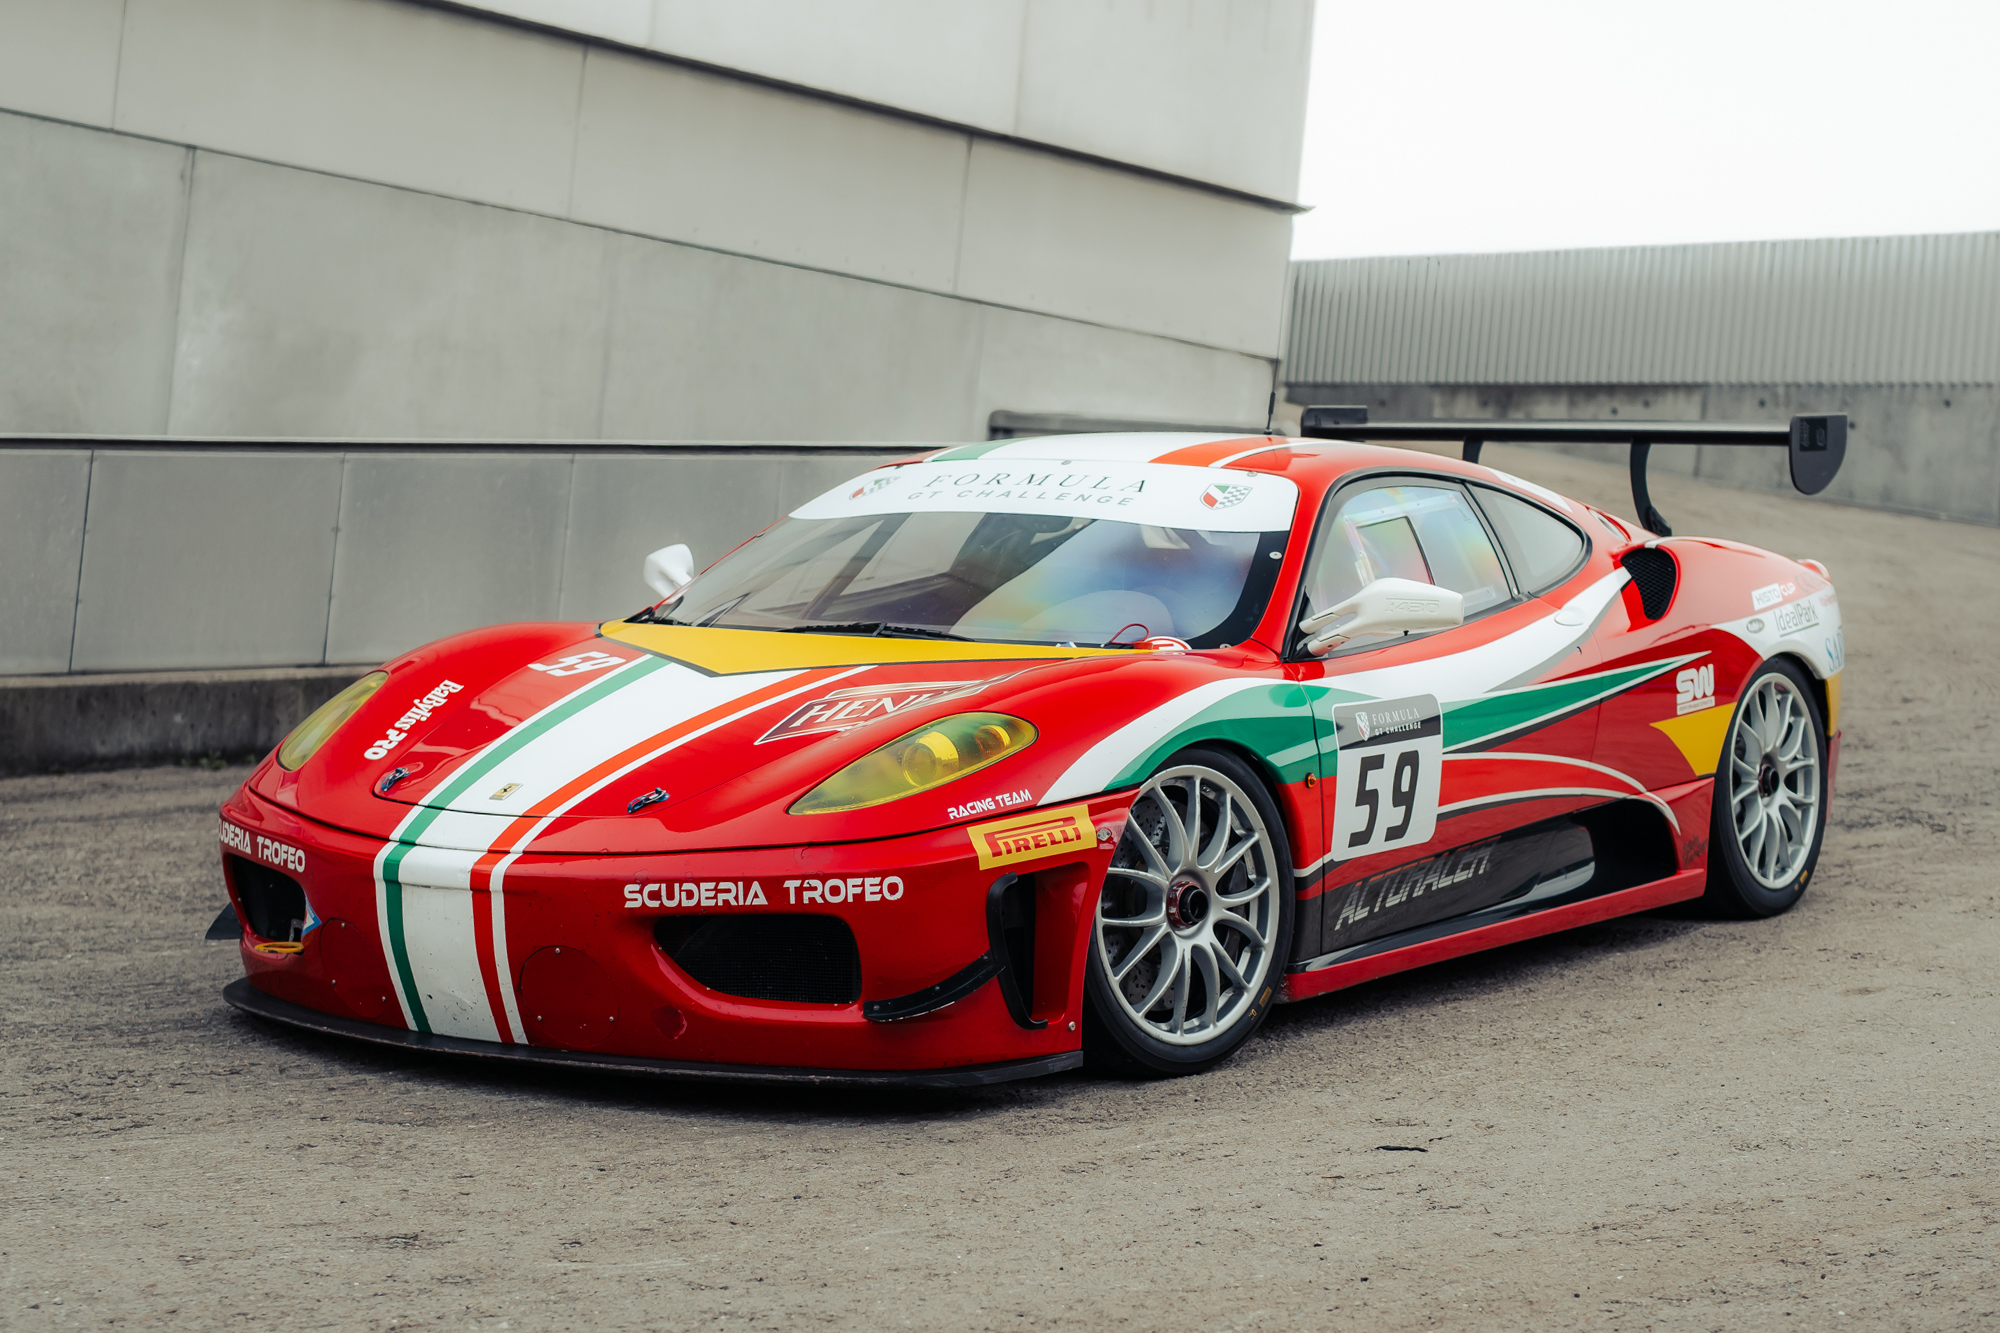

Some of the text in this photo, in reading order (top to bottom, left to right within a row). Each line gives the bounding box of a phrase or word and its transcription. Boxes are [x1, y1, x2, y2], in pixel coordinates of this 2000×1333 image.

[907, 489, 1135, 506] GT CHALLENGE
[923, 473, 1146, 494] FORMULA
[1773, 599, 1819, 632] IdealPark
[527, 651, 627, 677] 59
[363, 679, 465, 761] BaByliss PRO
[1371, 707, 1420, 725] FORMULA
[1385, 721, 1422, 734] CHALLENGE
[947, 788, 1033, 820] RACING TEAM
[1347, 749, 1420, 849] 59
[983, 816, 1082, 858] PIRELLI
[256, 835, 306, 873] TROFEO
[623, 875, 905, 909] SCUDERIA TROFEO
